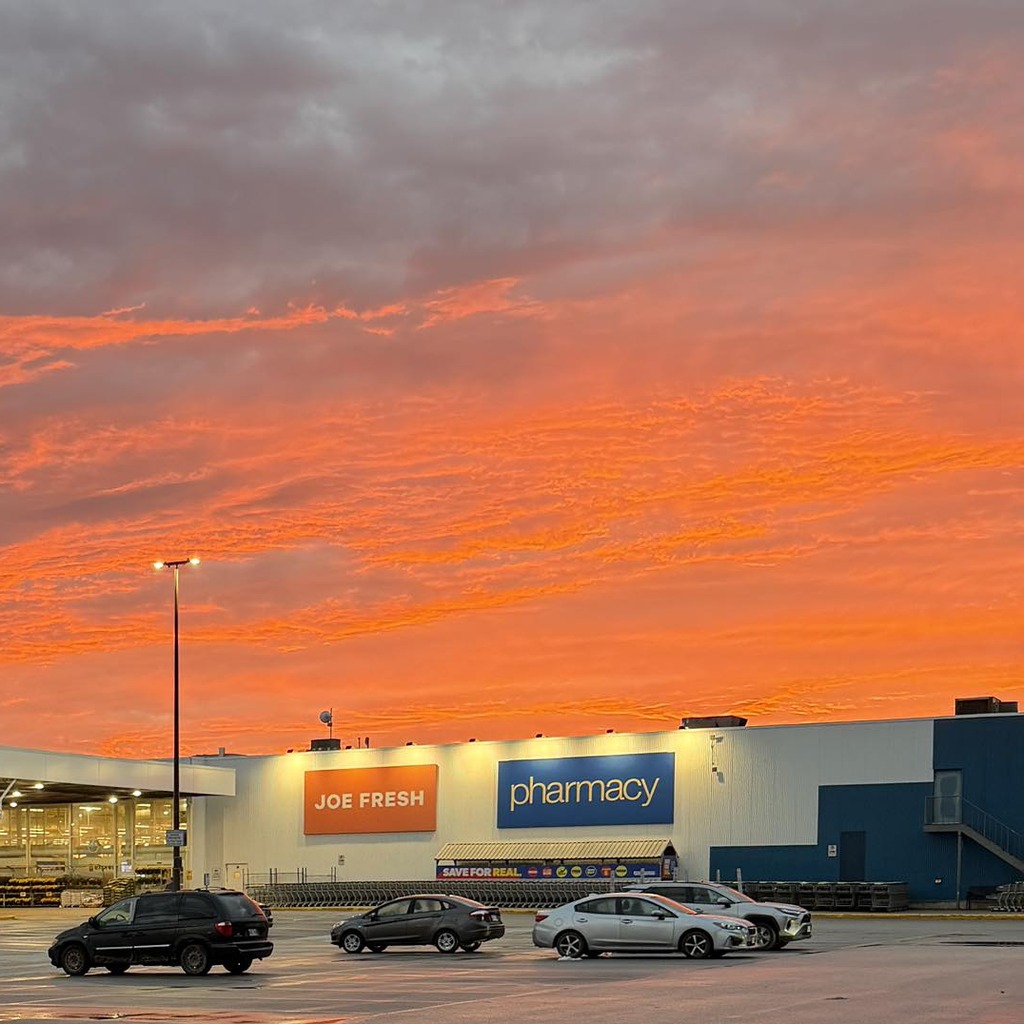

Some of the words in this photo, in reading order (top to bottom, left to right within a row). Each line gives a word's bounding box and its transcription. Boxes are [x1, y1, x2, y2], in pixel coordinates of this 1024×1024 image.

[314, 793, 353, 810] JOE
[359, 790, 424, 808] FRESH
[510, 776, 660, 812] pharmacy
[442, 867, 469, 877] SAVE
[470, 867, 491, 877] FOR
